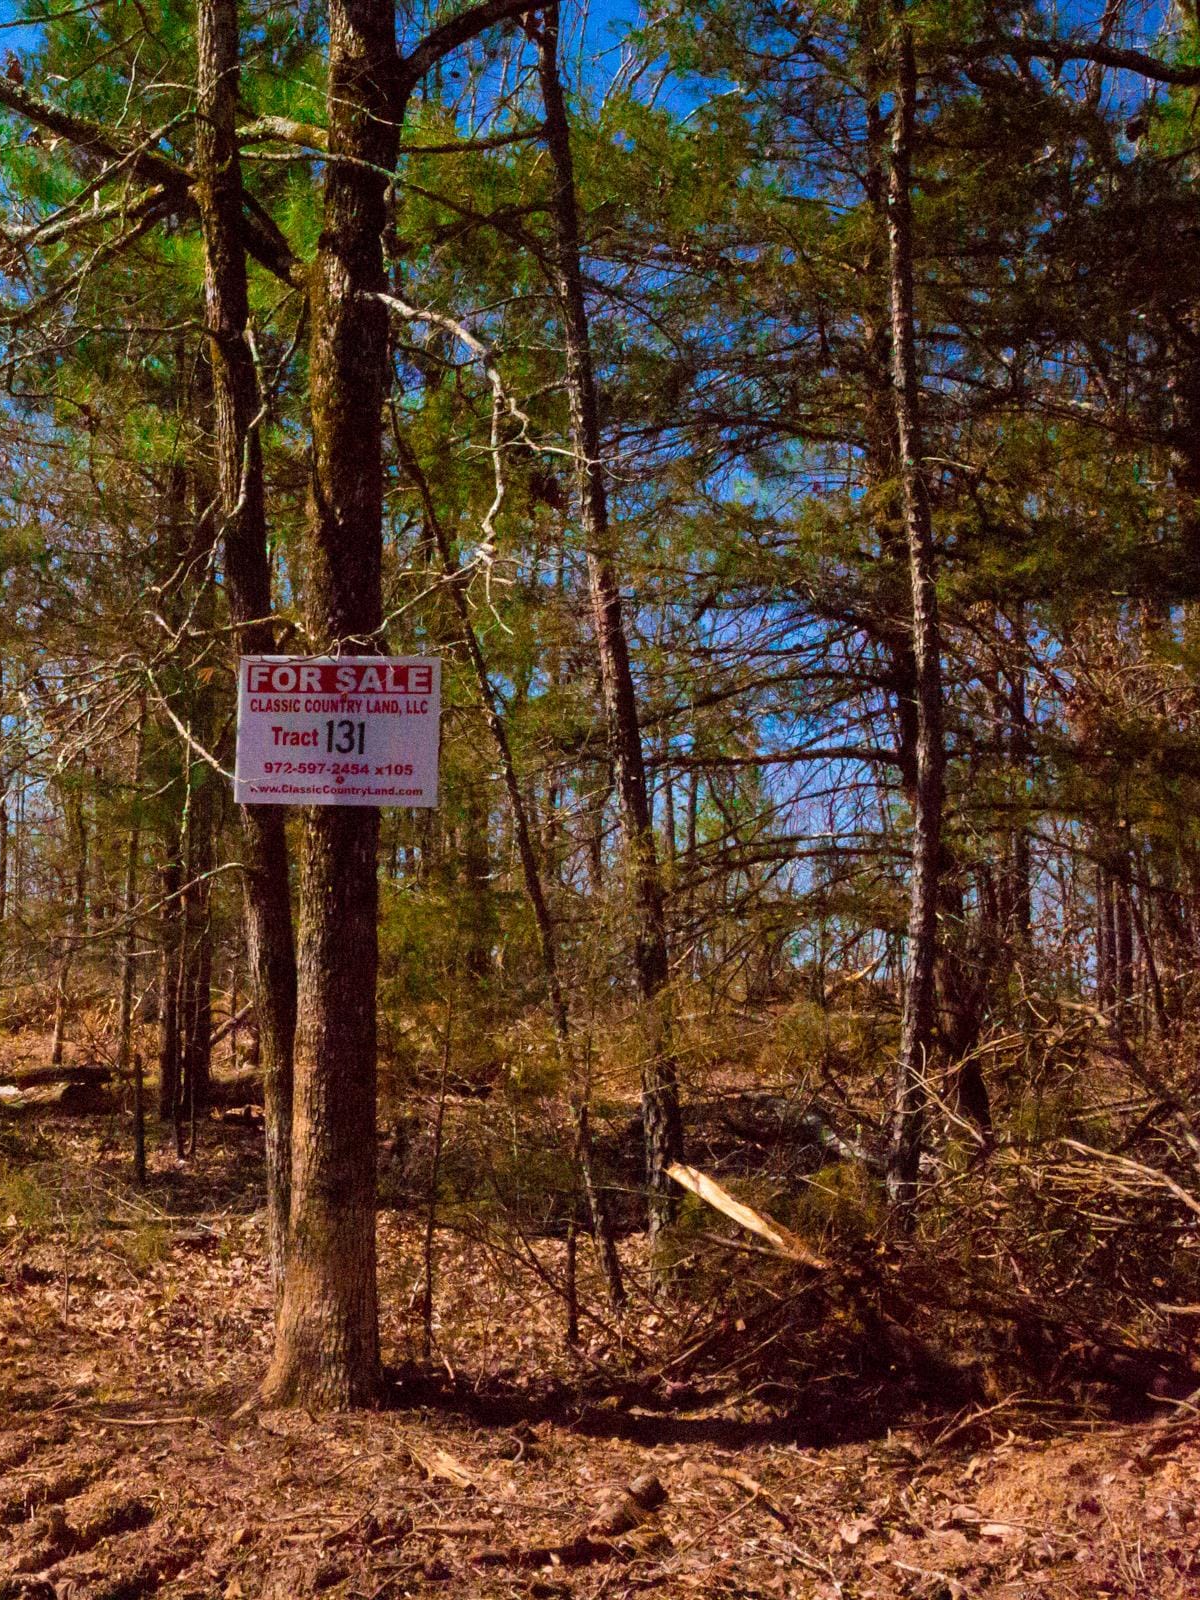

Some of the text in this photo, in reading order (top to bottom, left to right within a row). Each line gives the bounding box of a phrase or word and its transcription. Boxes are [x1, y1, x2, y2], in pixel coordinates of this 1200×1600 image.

[250, 667, 430, 693] FOR SALE
[250, 698, 429, 716] CLASSIC COUNTRY LAND, LLC
[271, 719, 366, 755] Tract 131
[263, 762, 414, 776] 972-597-2454 x105
